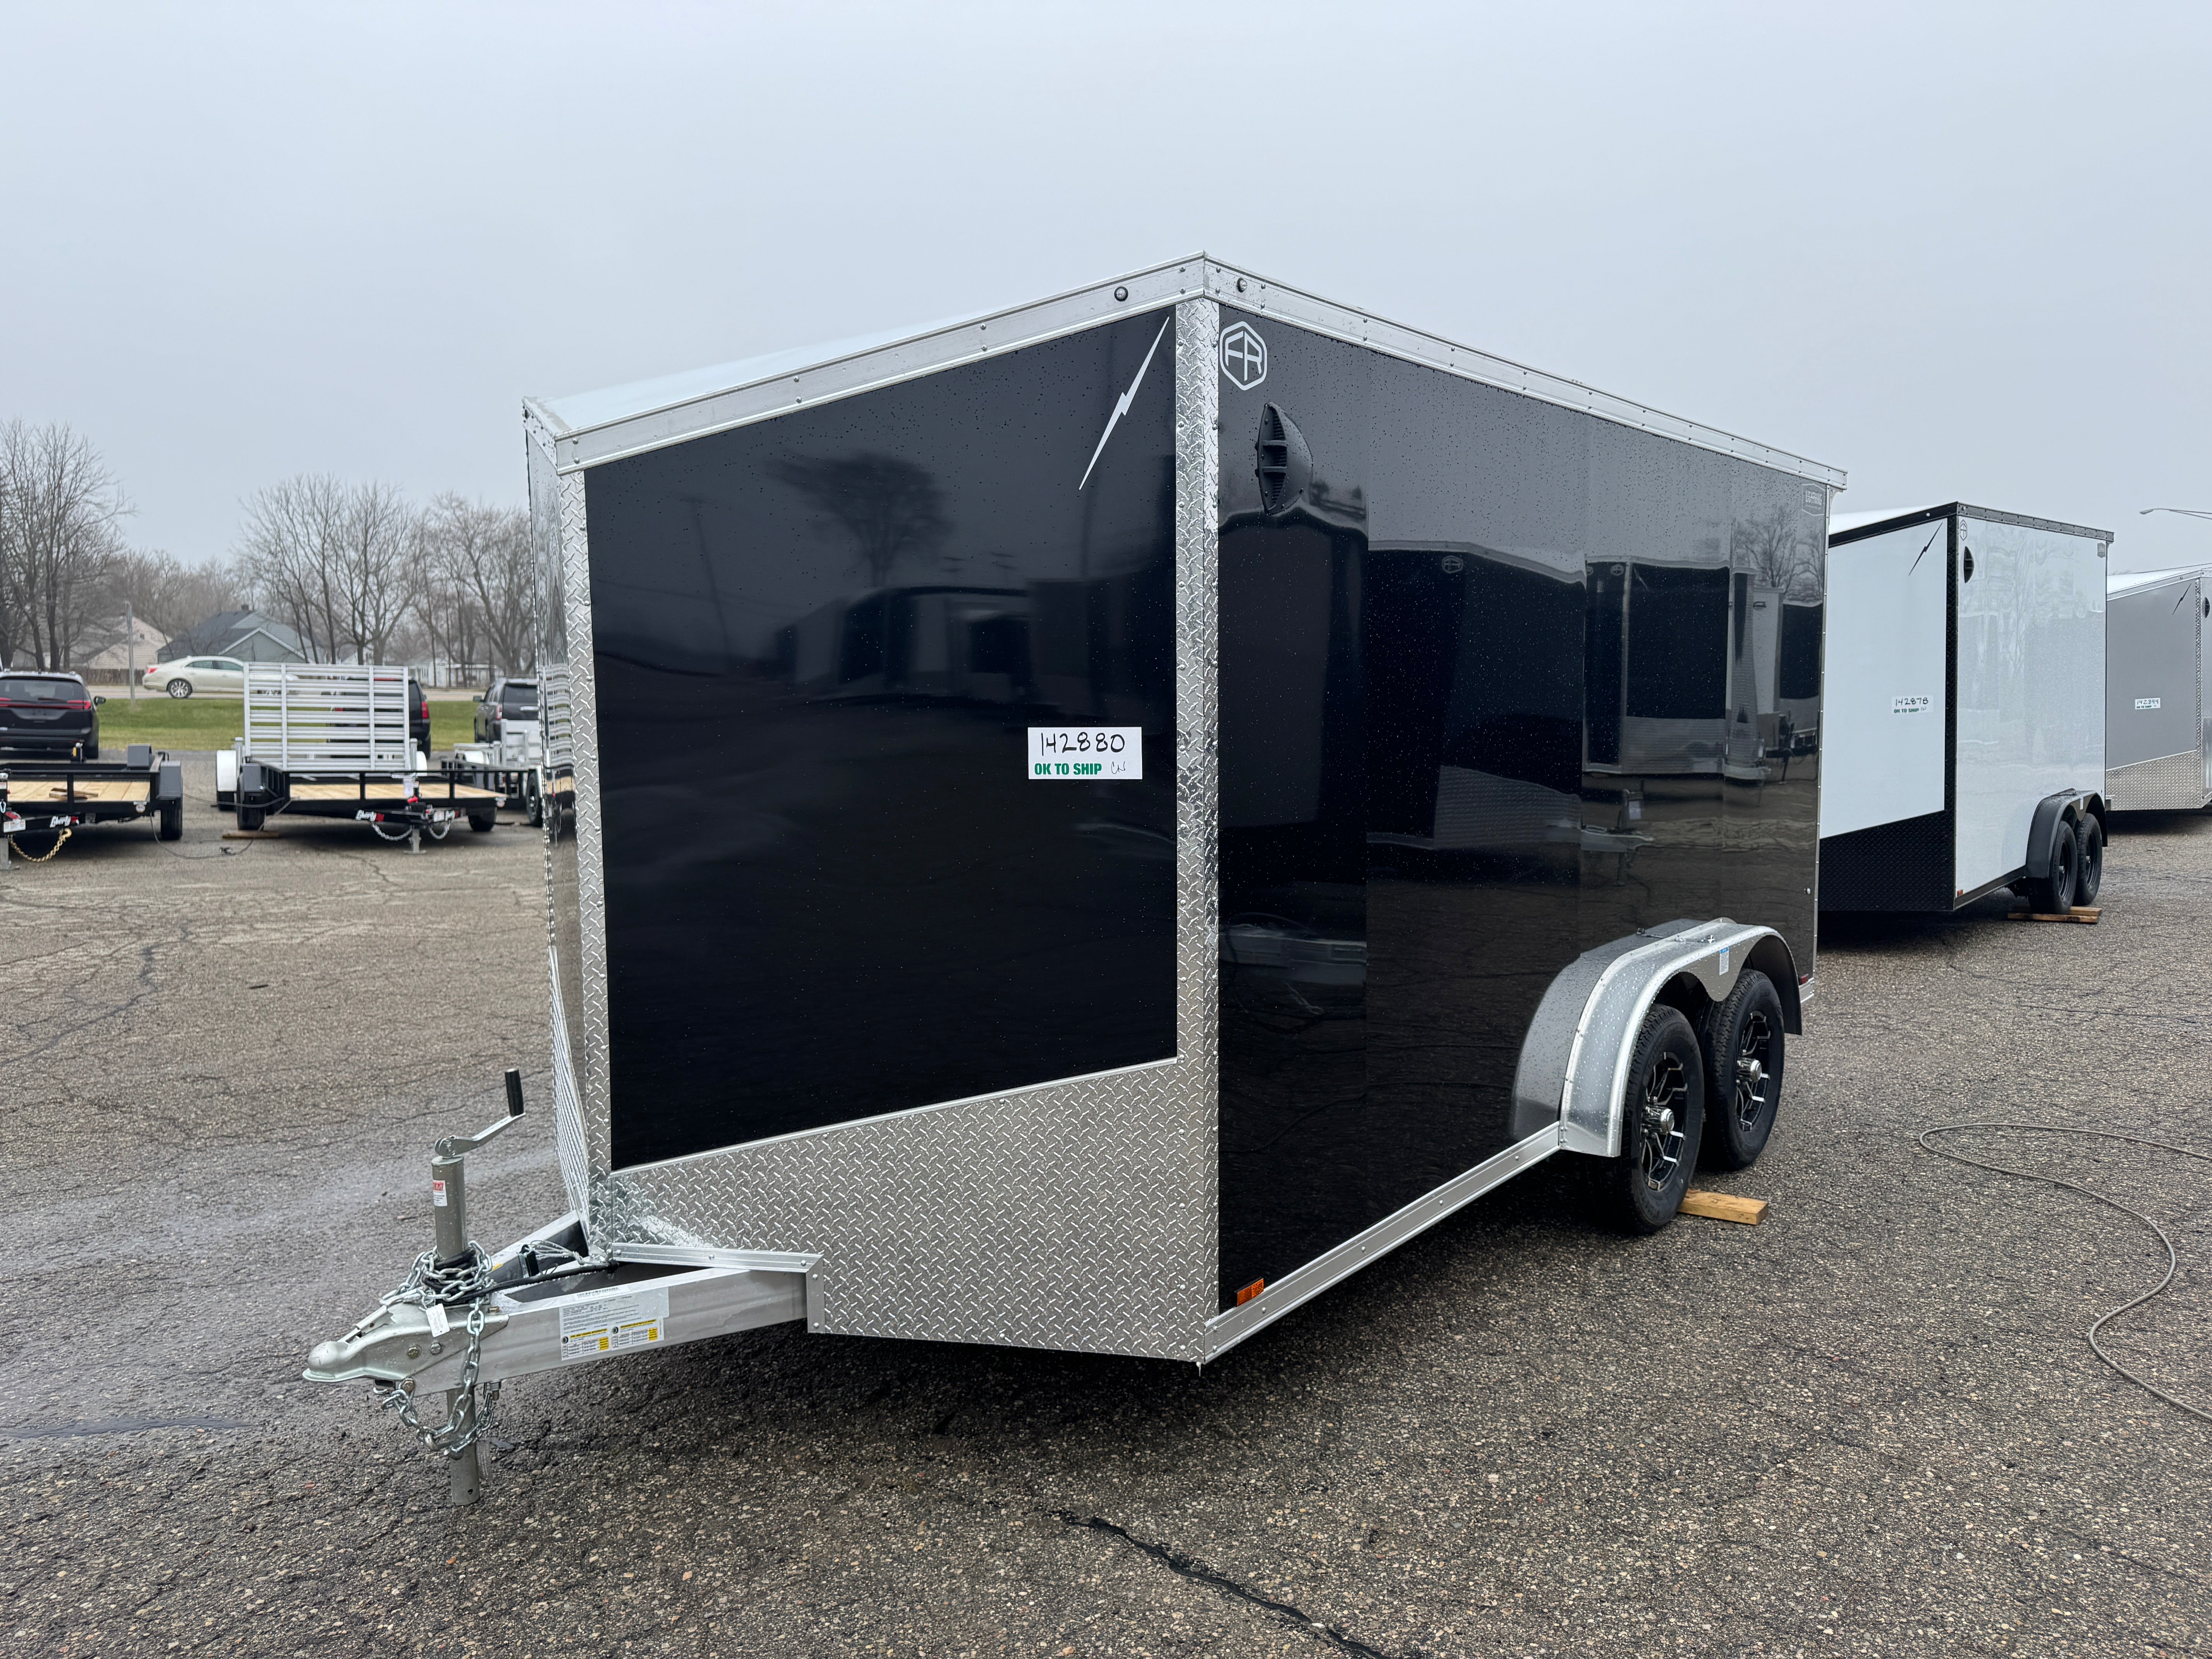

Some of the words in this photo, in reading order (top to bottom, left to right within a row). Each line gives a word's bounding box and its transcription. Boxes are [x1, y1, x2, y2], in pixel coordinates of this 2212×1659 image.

[1896, 697, 1929, 706] 142878
[1041, 732, 1125, 756] 142880
[1034, 763, 1051, 775] OK
[1054, 763, 1070, 775] TO
[1073, 763, 1102, 775] SHIP
